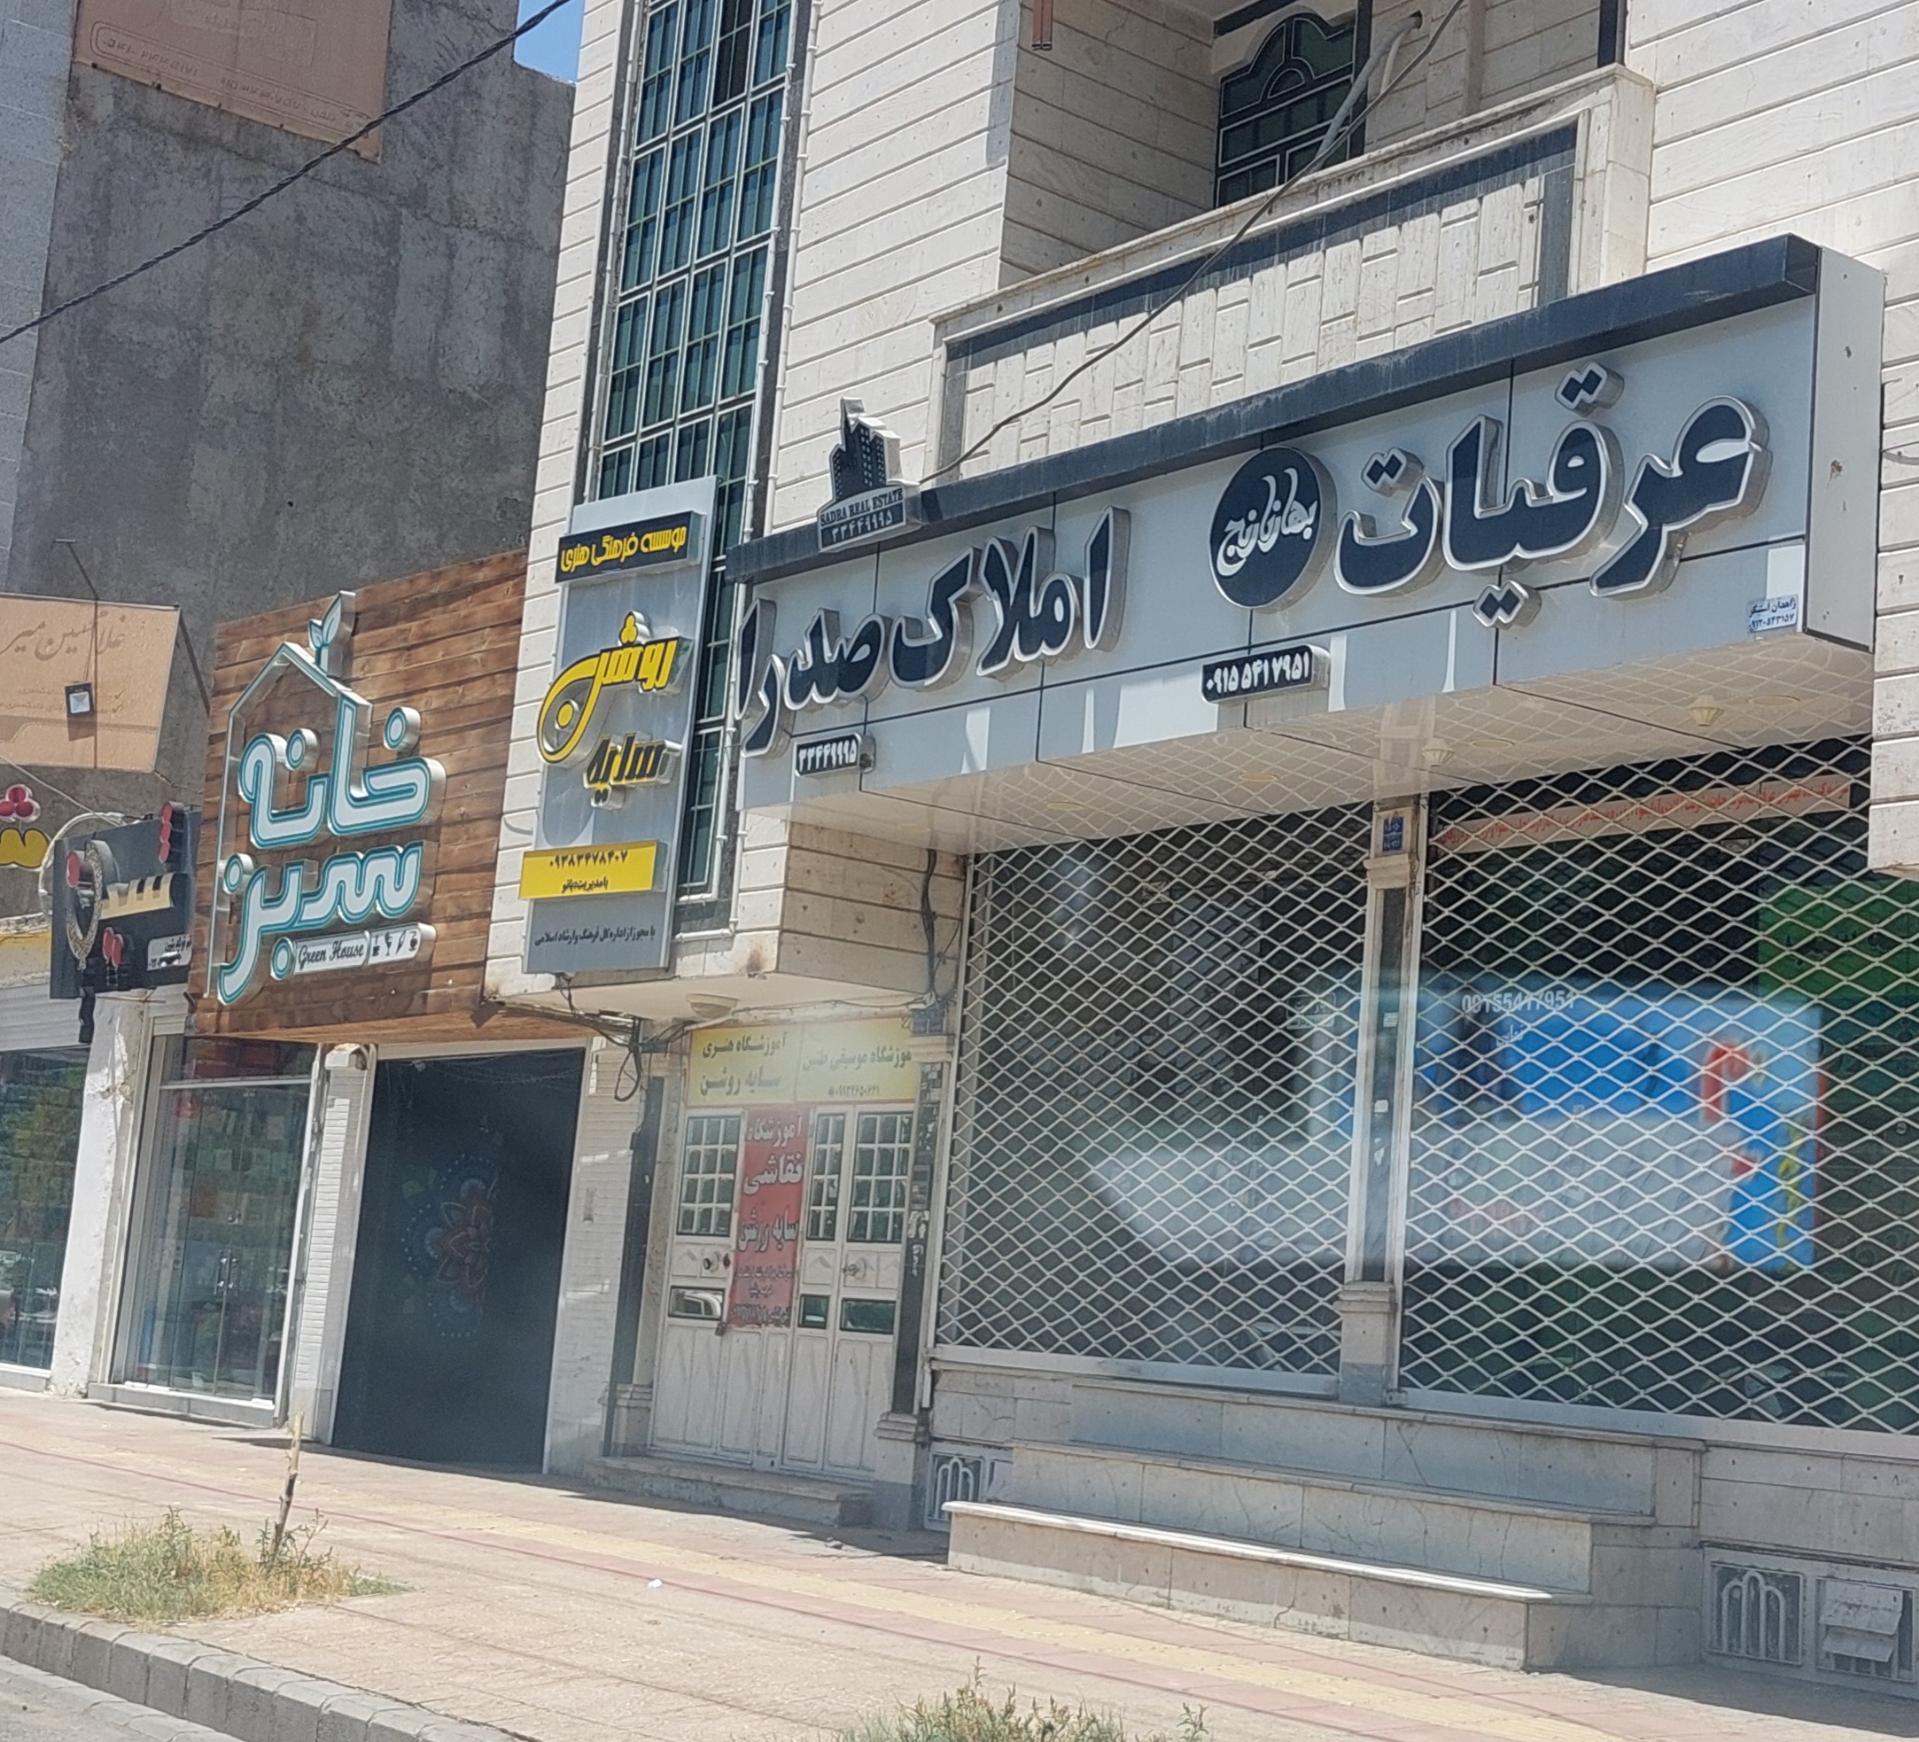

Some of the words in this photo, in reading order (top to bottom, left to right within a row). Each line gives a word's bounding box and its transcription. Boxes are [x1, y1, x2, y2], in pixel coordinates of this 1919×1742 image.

[820, 505, 848, 526] SADRA
[848, 500, 871, 518] REAL
[872, 487, 903, 509] ESTATE
[1336, 362, 1760, 628] عرقیات
[560, 543, 590, 573] هنری
[591, 532, 639, 566] فرهنگی
[640, 526, 687, 554] موسسه
[888, 505, 1120, 689] املاک
[536, 610, 680, 766] روشن
[735, 598, 888, 758] صدرا
[238, 697, 436, 850] خانه
[584, 730, 668, 807] سایه
[218, 840, 426, 1006] سبز
[298, 943, 327, 970] Green
[329, 940, 364, 961] House
[870, 1044, 912, 1068] موزشگاه
[699, 1066, 741, 1097] روشن
[743, 1152, 803, 1195] نقاشی
